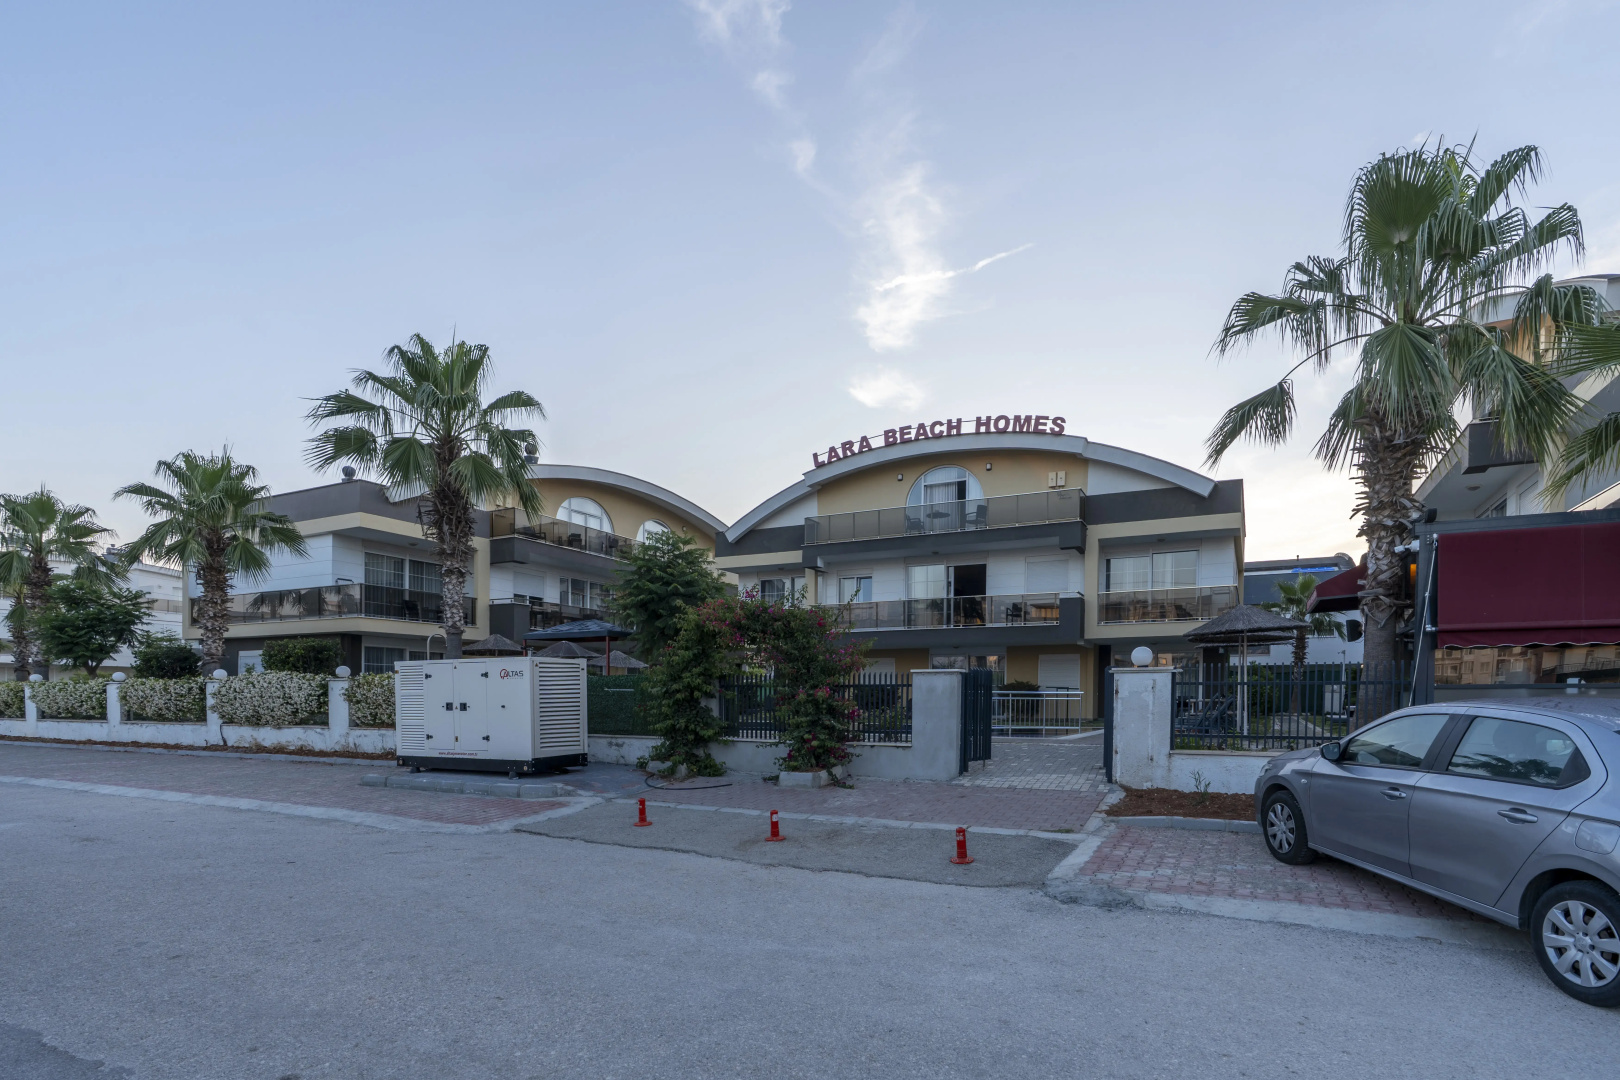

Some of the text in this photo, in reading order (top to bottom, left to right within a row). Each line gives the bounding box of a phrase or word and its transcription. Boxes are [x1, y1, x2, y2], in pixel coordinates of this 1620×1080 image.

[812, 414, 1067, 467] LARA BEACH HOMES
